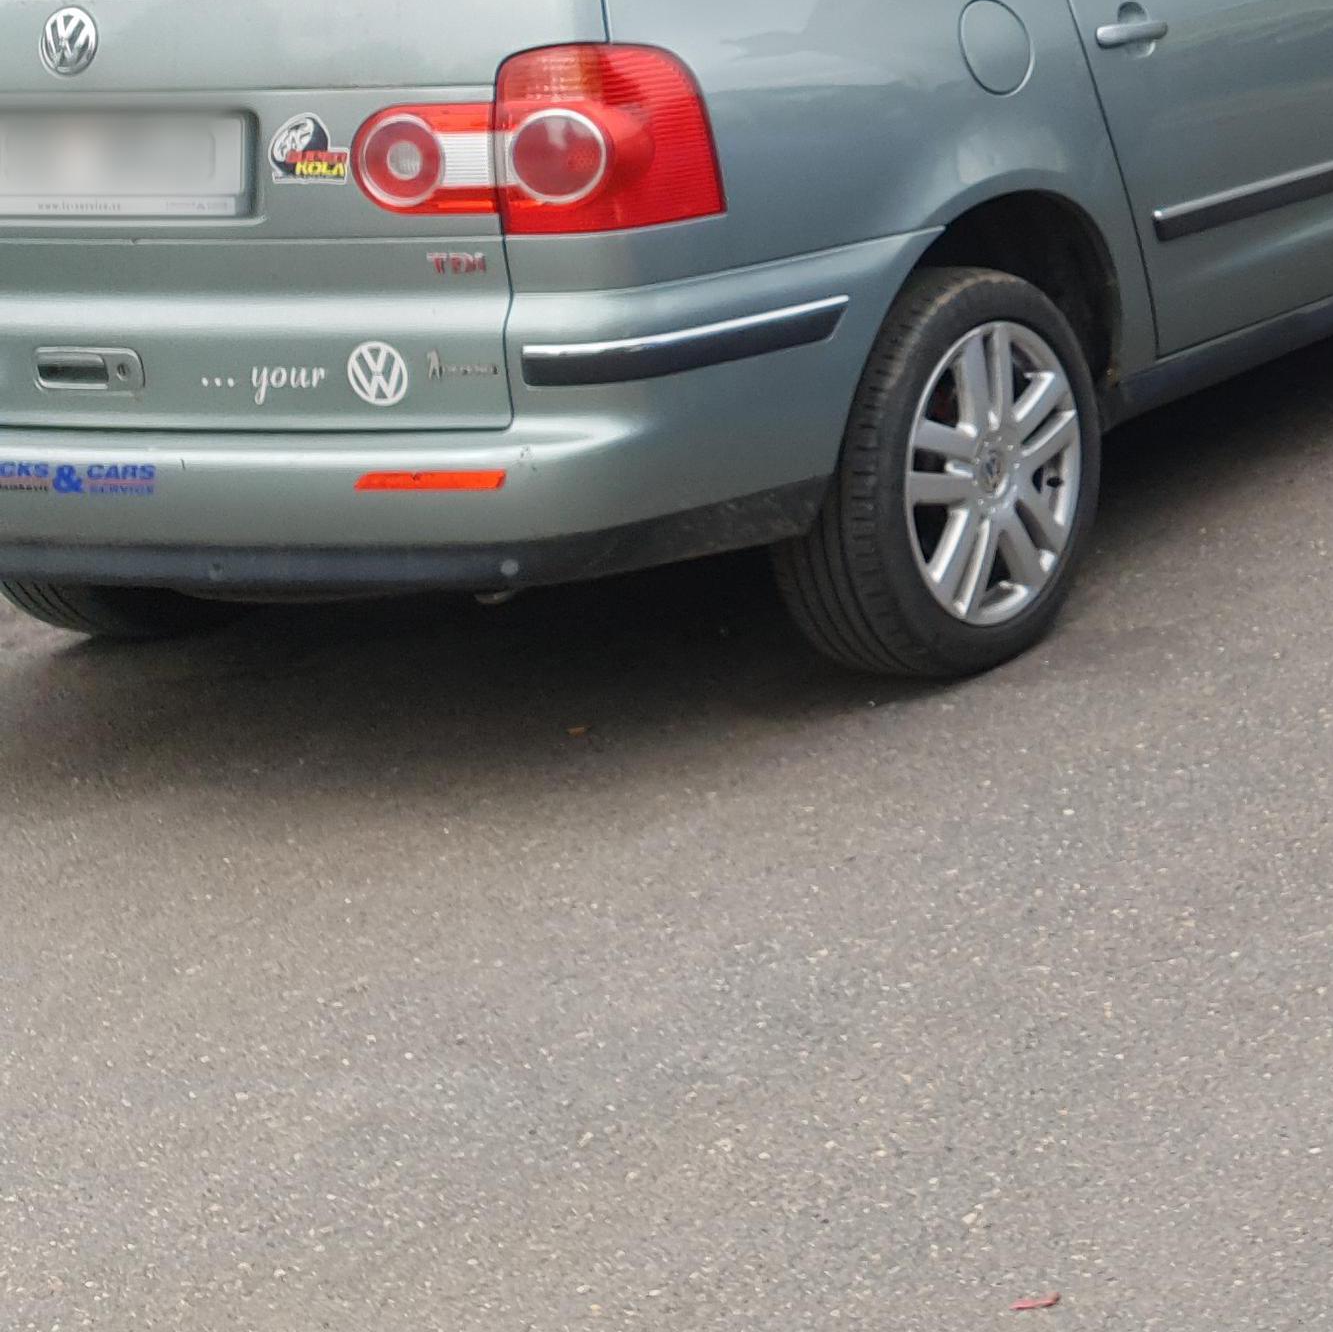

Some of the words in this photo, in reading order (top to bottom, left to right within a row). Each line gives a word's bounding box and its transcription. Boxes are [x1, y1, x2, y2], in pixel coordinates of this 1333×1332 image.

[295, 160, 345, 177] KOLA
[250, 366, 326, 406] your
[0, 461, 49, 478] CKS
[52, 464, 84, 494] &
[86, 464, 156, 480] CARS
